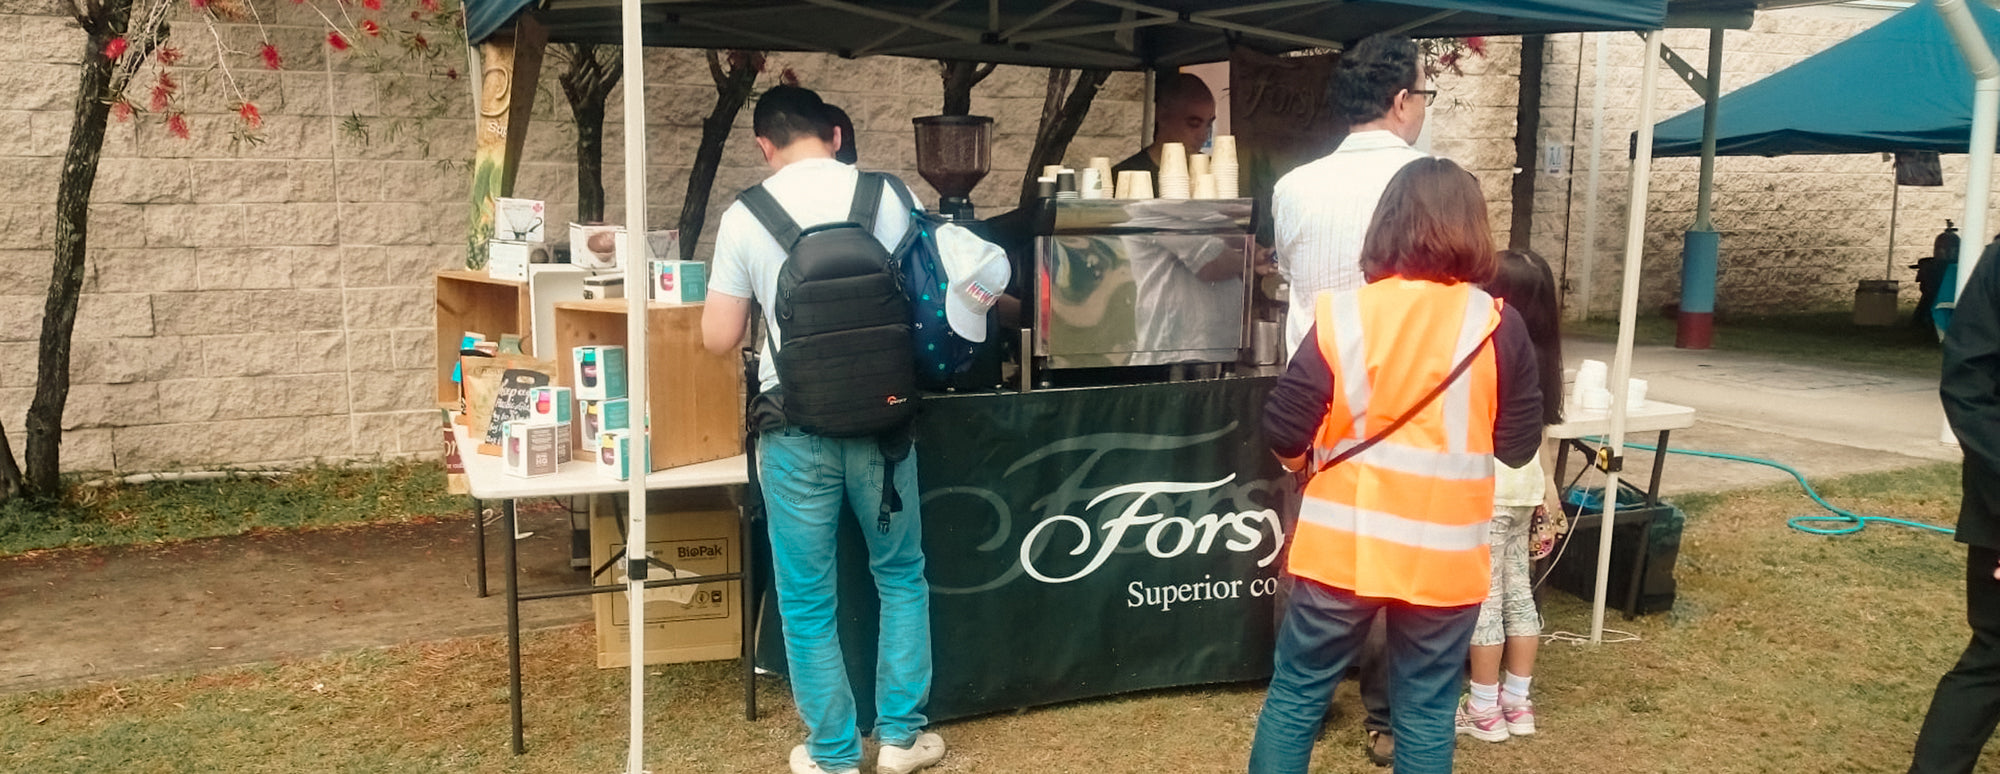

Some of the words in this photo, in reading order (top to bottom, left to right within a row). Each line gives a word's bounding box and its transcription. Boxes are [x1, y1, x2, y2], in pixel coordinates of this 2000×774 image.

[1020, 472, 1285, 584] Forsy
[677, 544, 722, 558] BioPak
[1127, 574, 1243, 612] Superior
[1250, 577, 1278, 597] co
